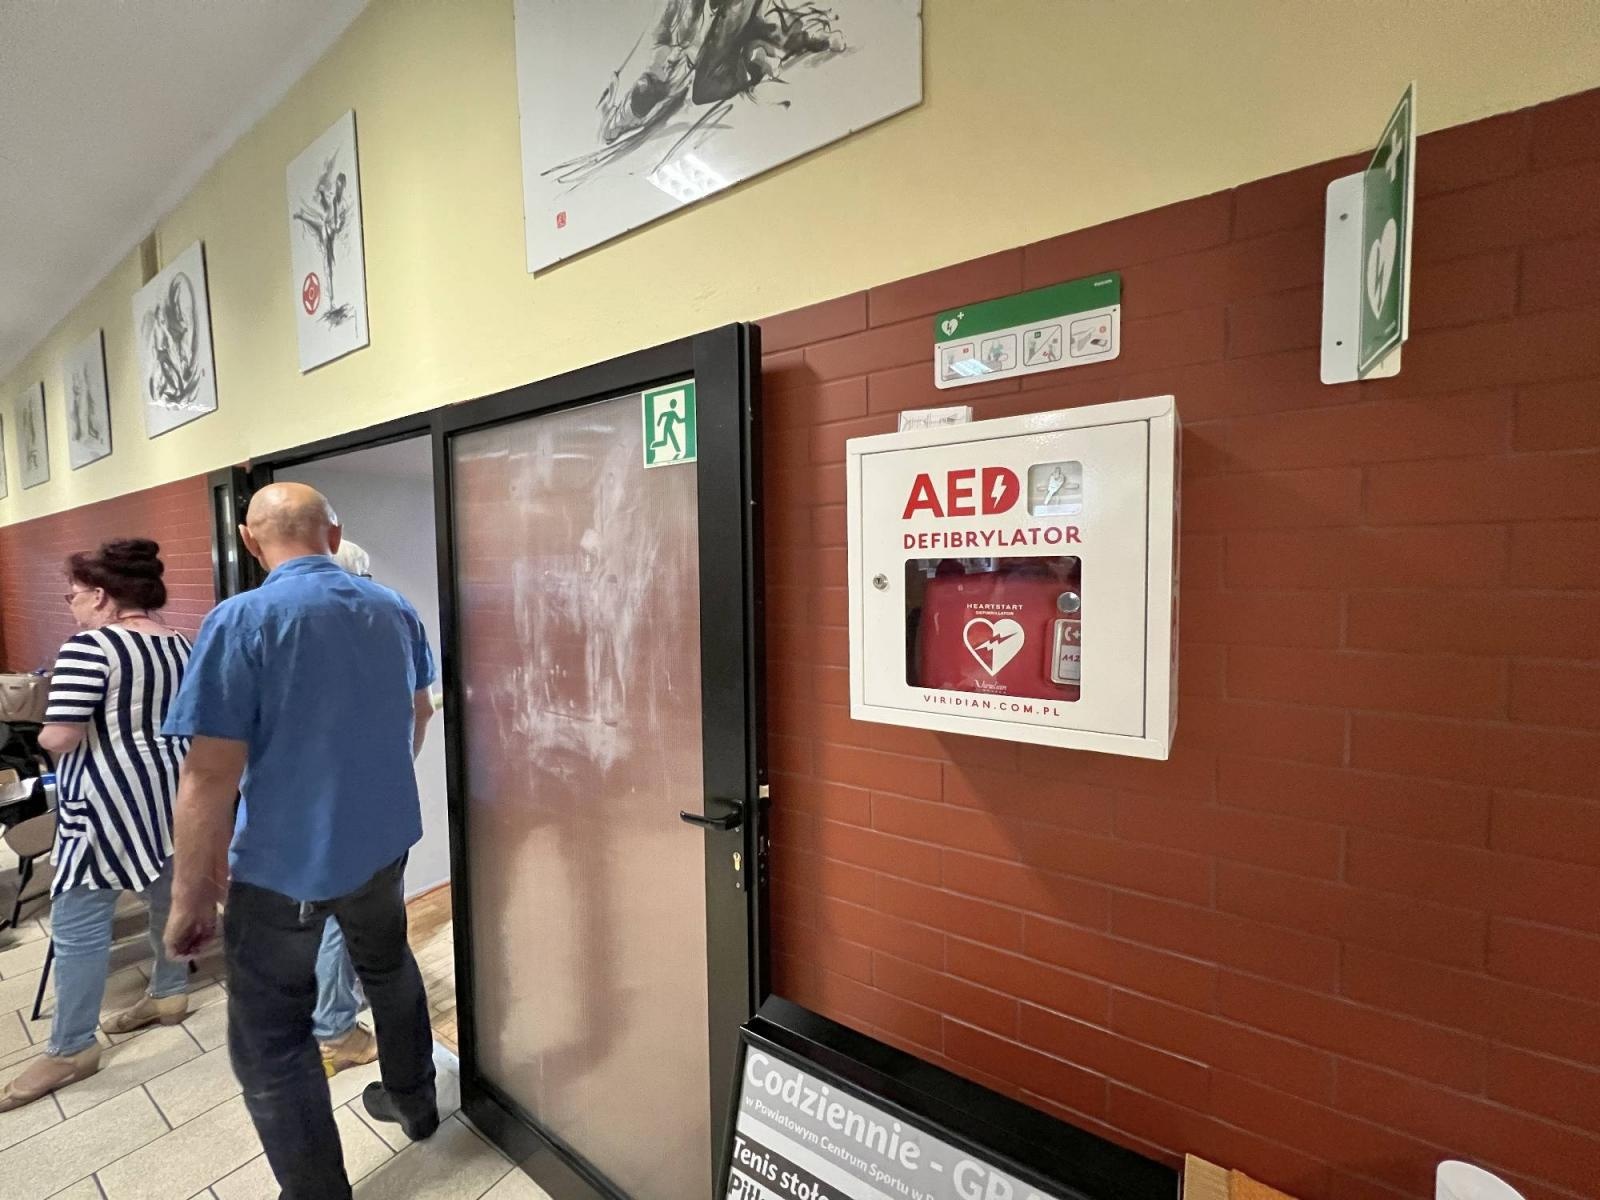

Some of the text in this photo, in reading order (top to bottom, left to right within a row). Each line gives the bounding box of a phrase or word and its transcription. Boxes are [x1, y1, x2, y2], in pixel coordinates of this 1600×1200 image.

[902, 466, 1020, 520] AED
[903, 525, 1082, 549] DEFIBRYLATOR
[923, 695, 1060, 717] VIRIDIAN.COM.PL
[746, 1053, 920, 1170] Codziennie
[733, 1136, 830, 1200] Tenis stoł
[745, 1096, 754, 1106] w
[755, 1099, 819, 1145] Powiatowym
[820, 1136, 868, 1172] Centrum
[868, 1163, 909, 1195] Sportu
